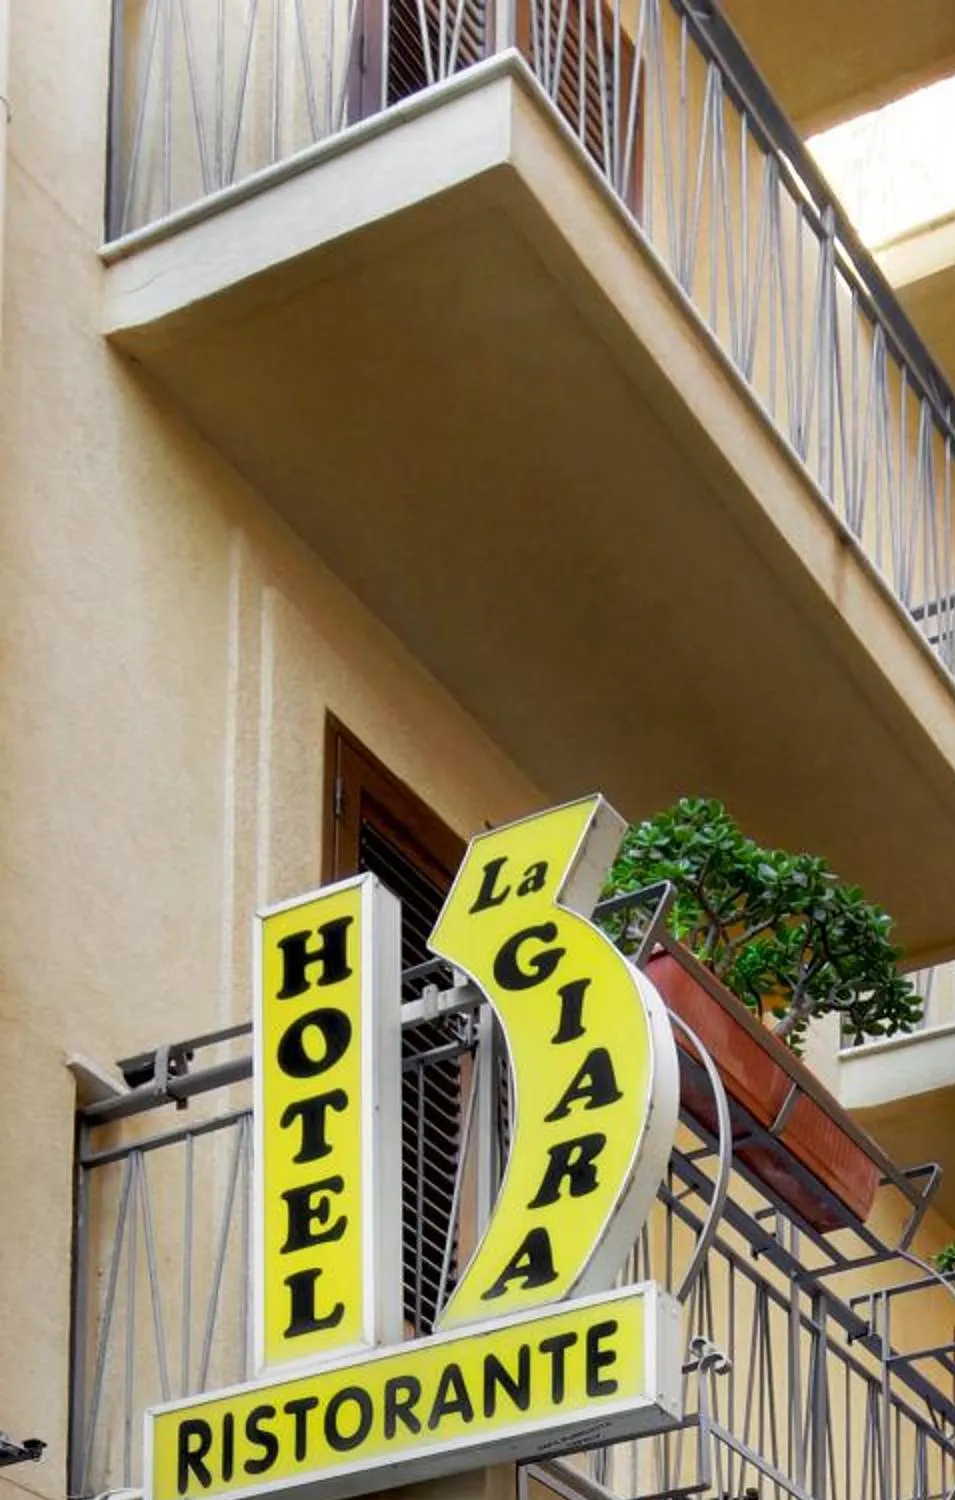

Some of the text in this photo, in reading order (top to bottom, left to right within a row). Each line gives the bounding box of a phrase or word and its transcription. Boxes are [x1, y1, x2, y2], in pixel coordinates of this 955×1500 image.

[468, 855, 550, 916] La
[275, 914, 355, 1340] HOTEL
[481, 920, 624, 1302] GIARA
[176, 1318, 619, 1496] RISTORANTE
